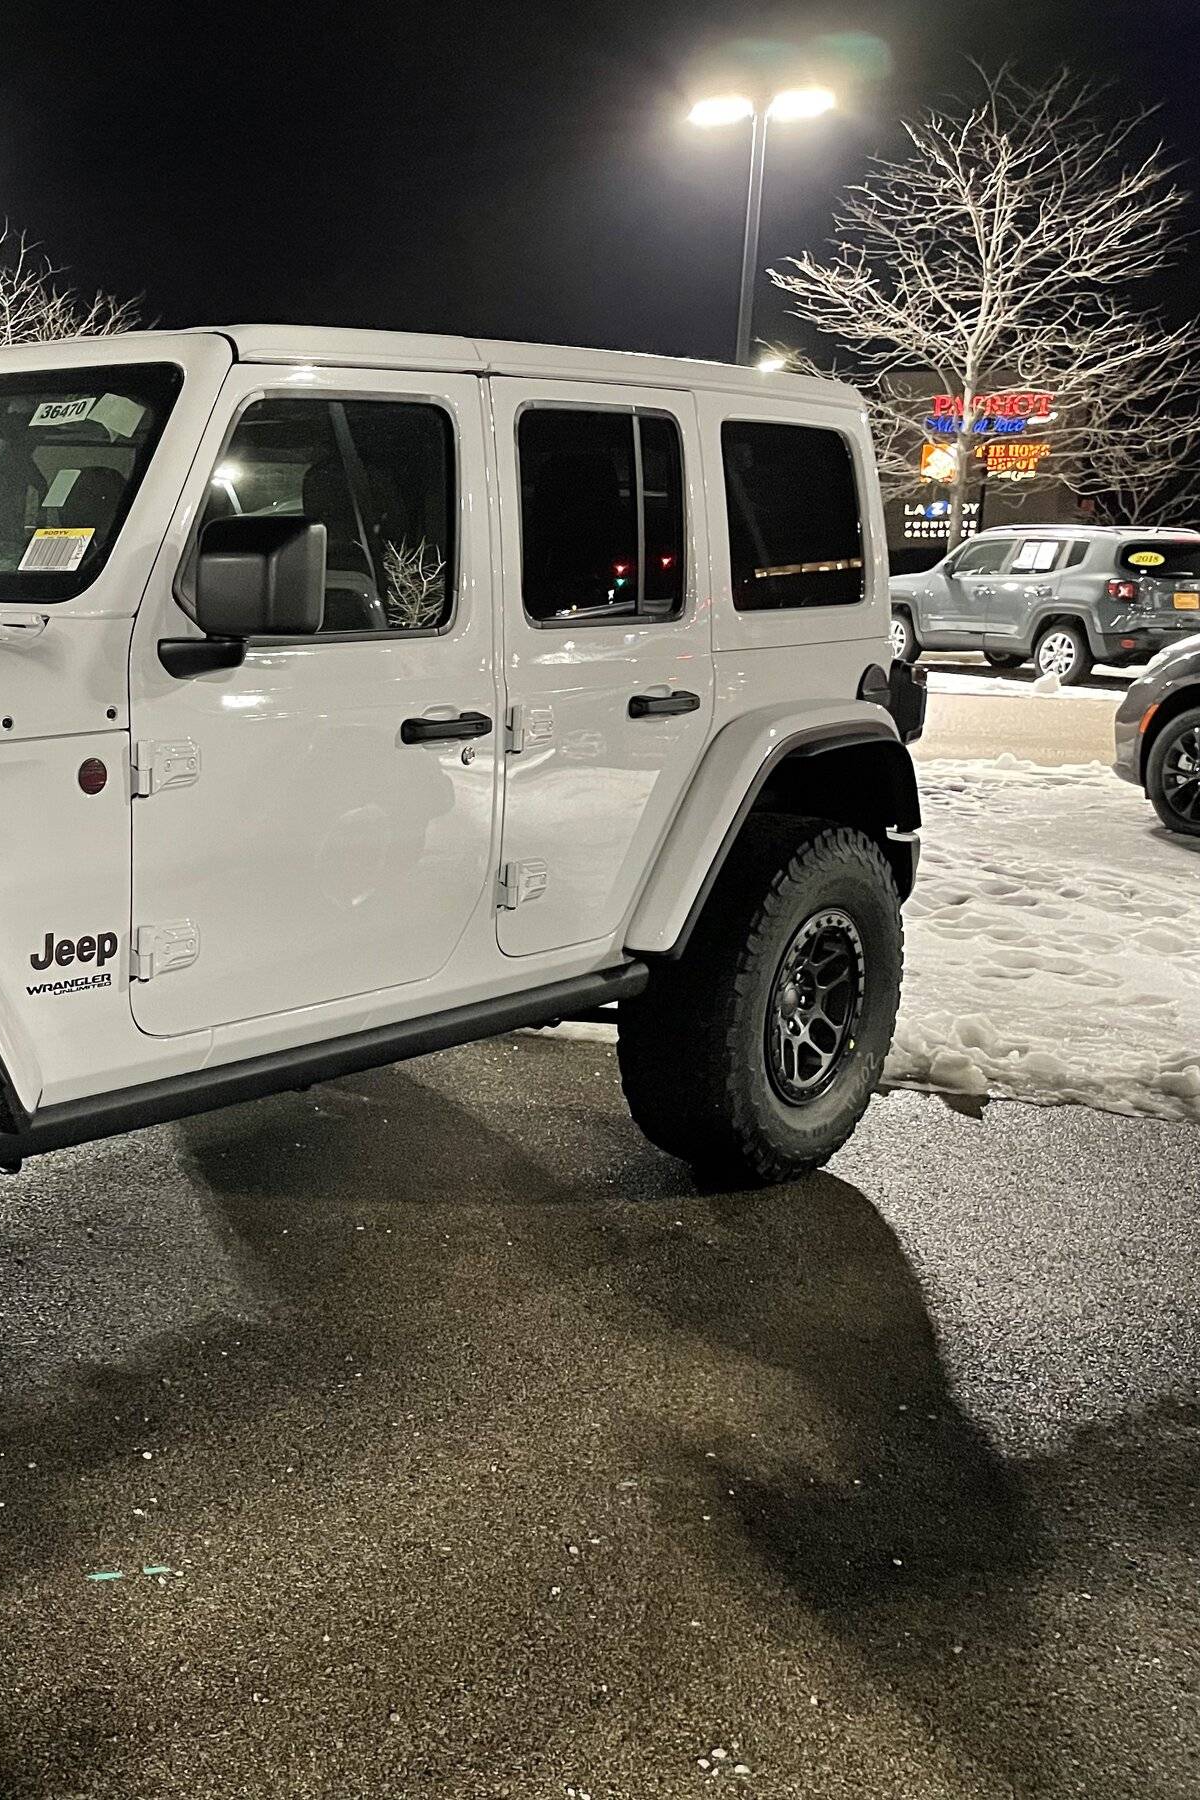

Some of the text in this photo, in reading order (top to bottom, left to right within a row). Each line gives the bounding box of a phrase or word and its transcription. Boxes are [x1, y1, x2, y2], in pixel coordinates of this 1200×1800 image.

[41, 401, 87, 419] 36470
[1135, 555, 1159, 563] 2018
[30, 931, 118, 971] Jeep
[26, 973, 112, 996] WRANGLER
[53, 981, 112, 996] UNLIMITED
